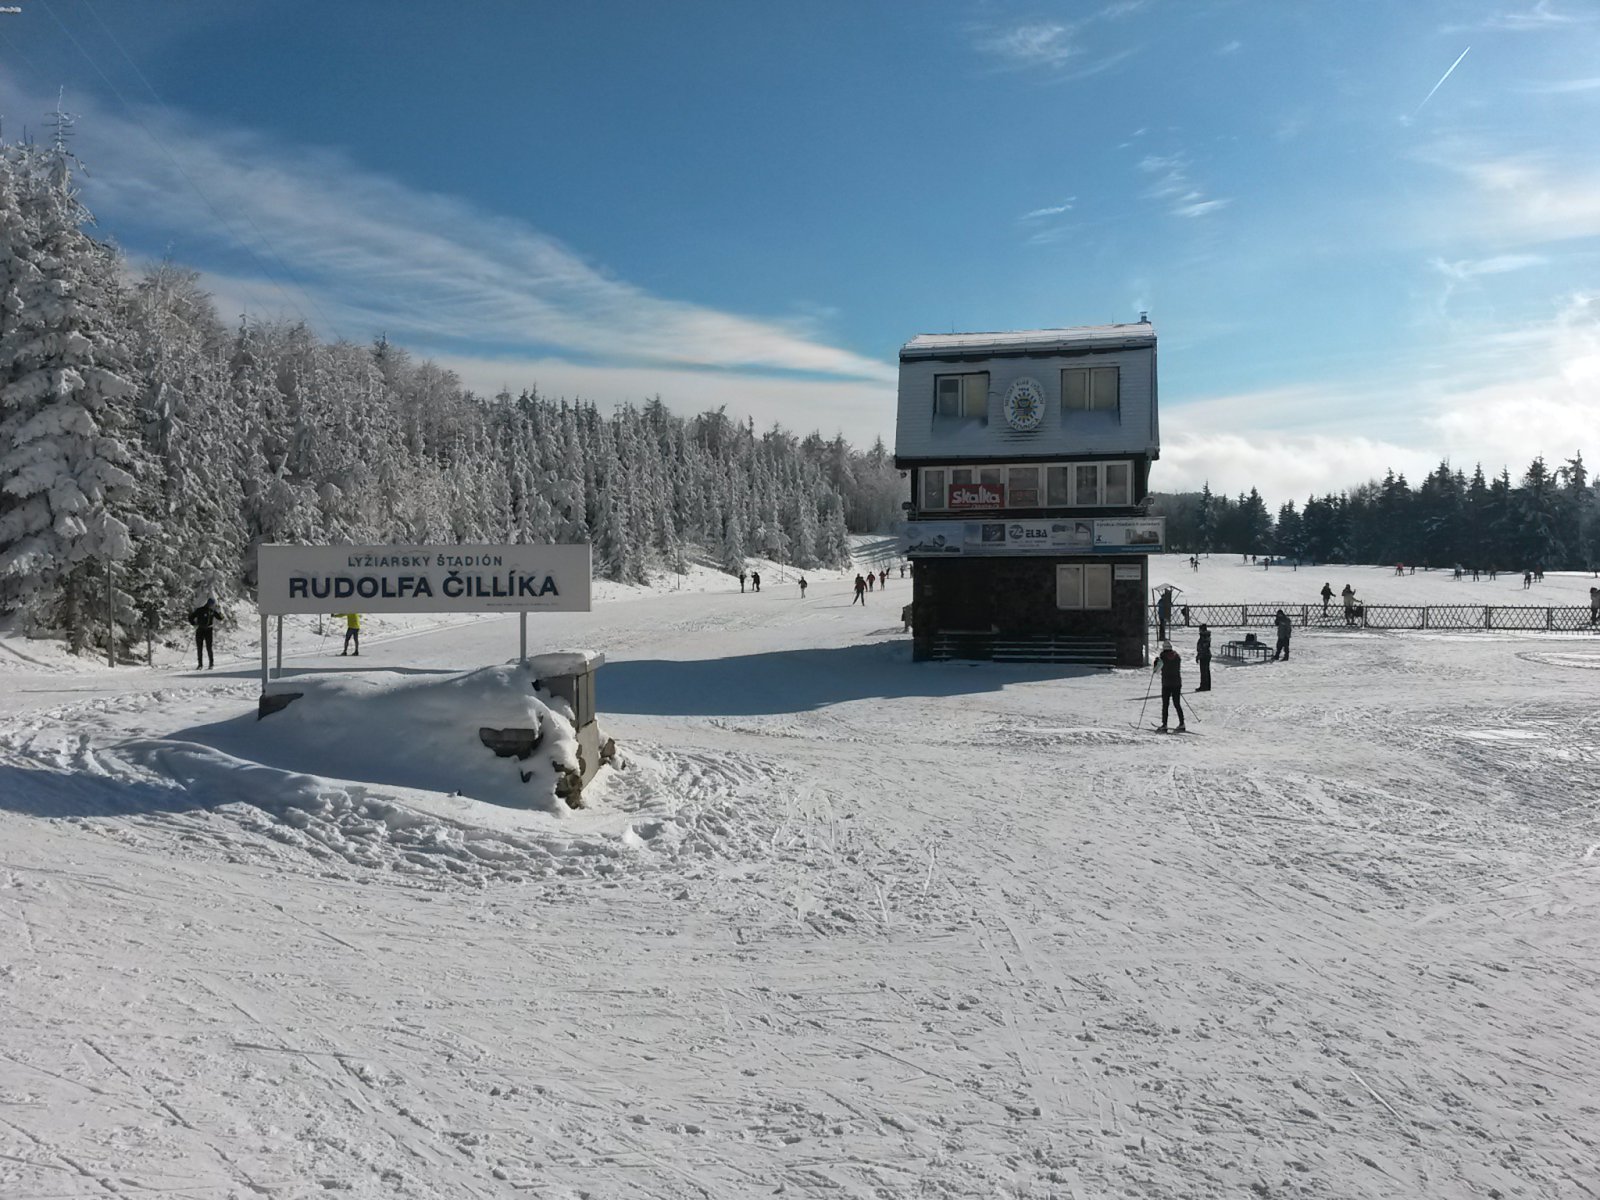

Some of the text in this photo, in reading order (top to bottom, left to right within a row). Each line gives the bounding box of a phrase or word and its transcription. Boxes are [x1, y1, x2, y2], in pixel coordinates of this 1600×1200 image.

[951, 485, 1000, 504] Skalka
[1025, 529, 1048, 538] ELBA
[348, 553, 503, 567] LYŽIARSKY ŠTADIÓN
[289, 569, 559, 599] RUDOLFA ČILLÍKA
